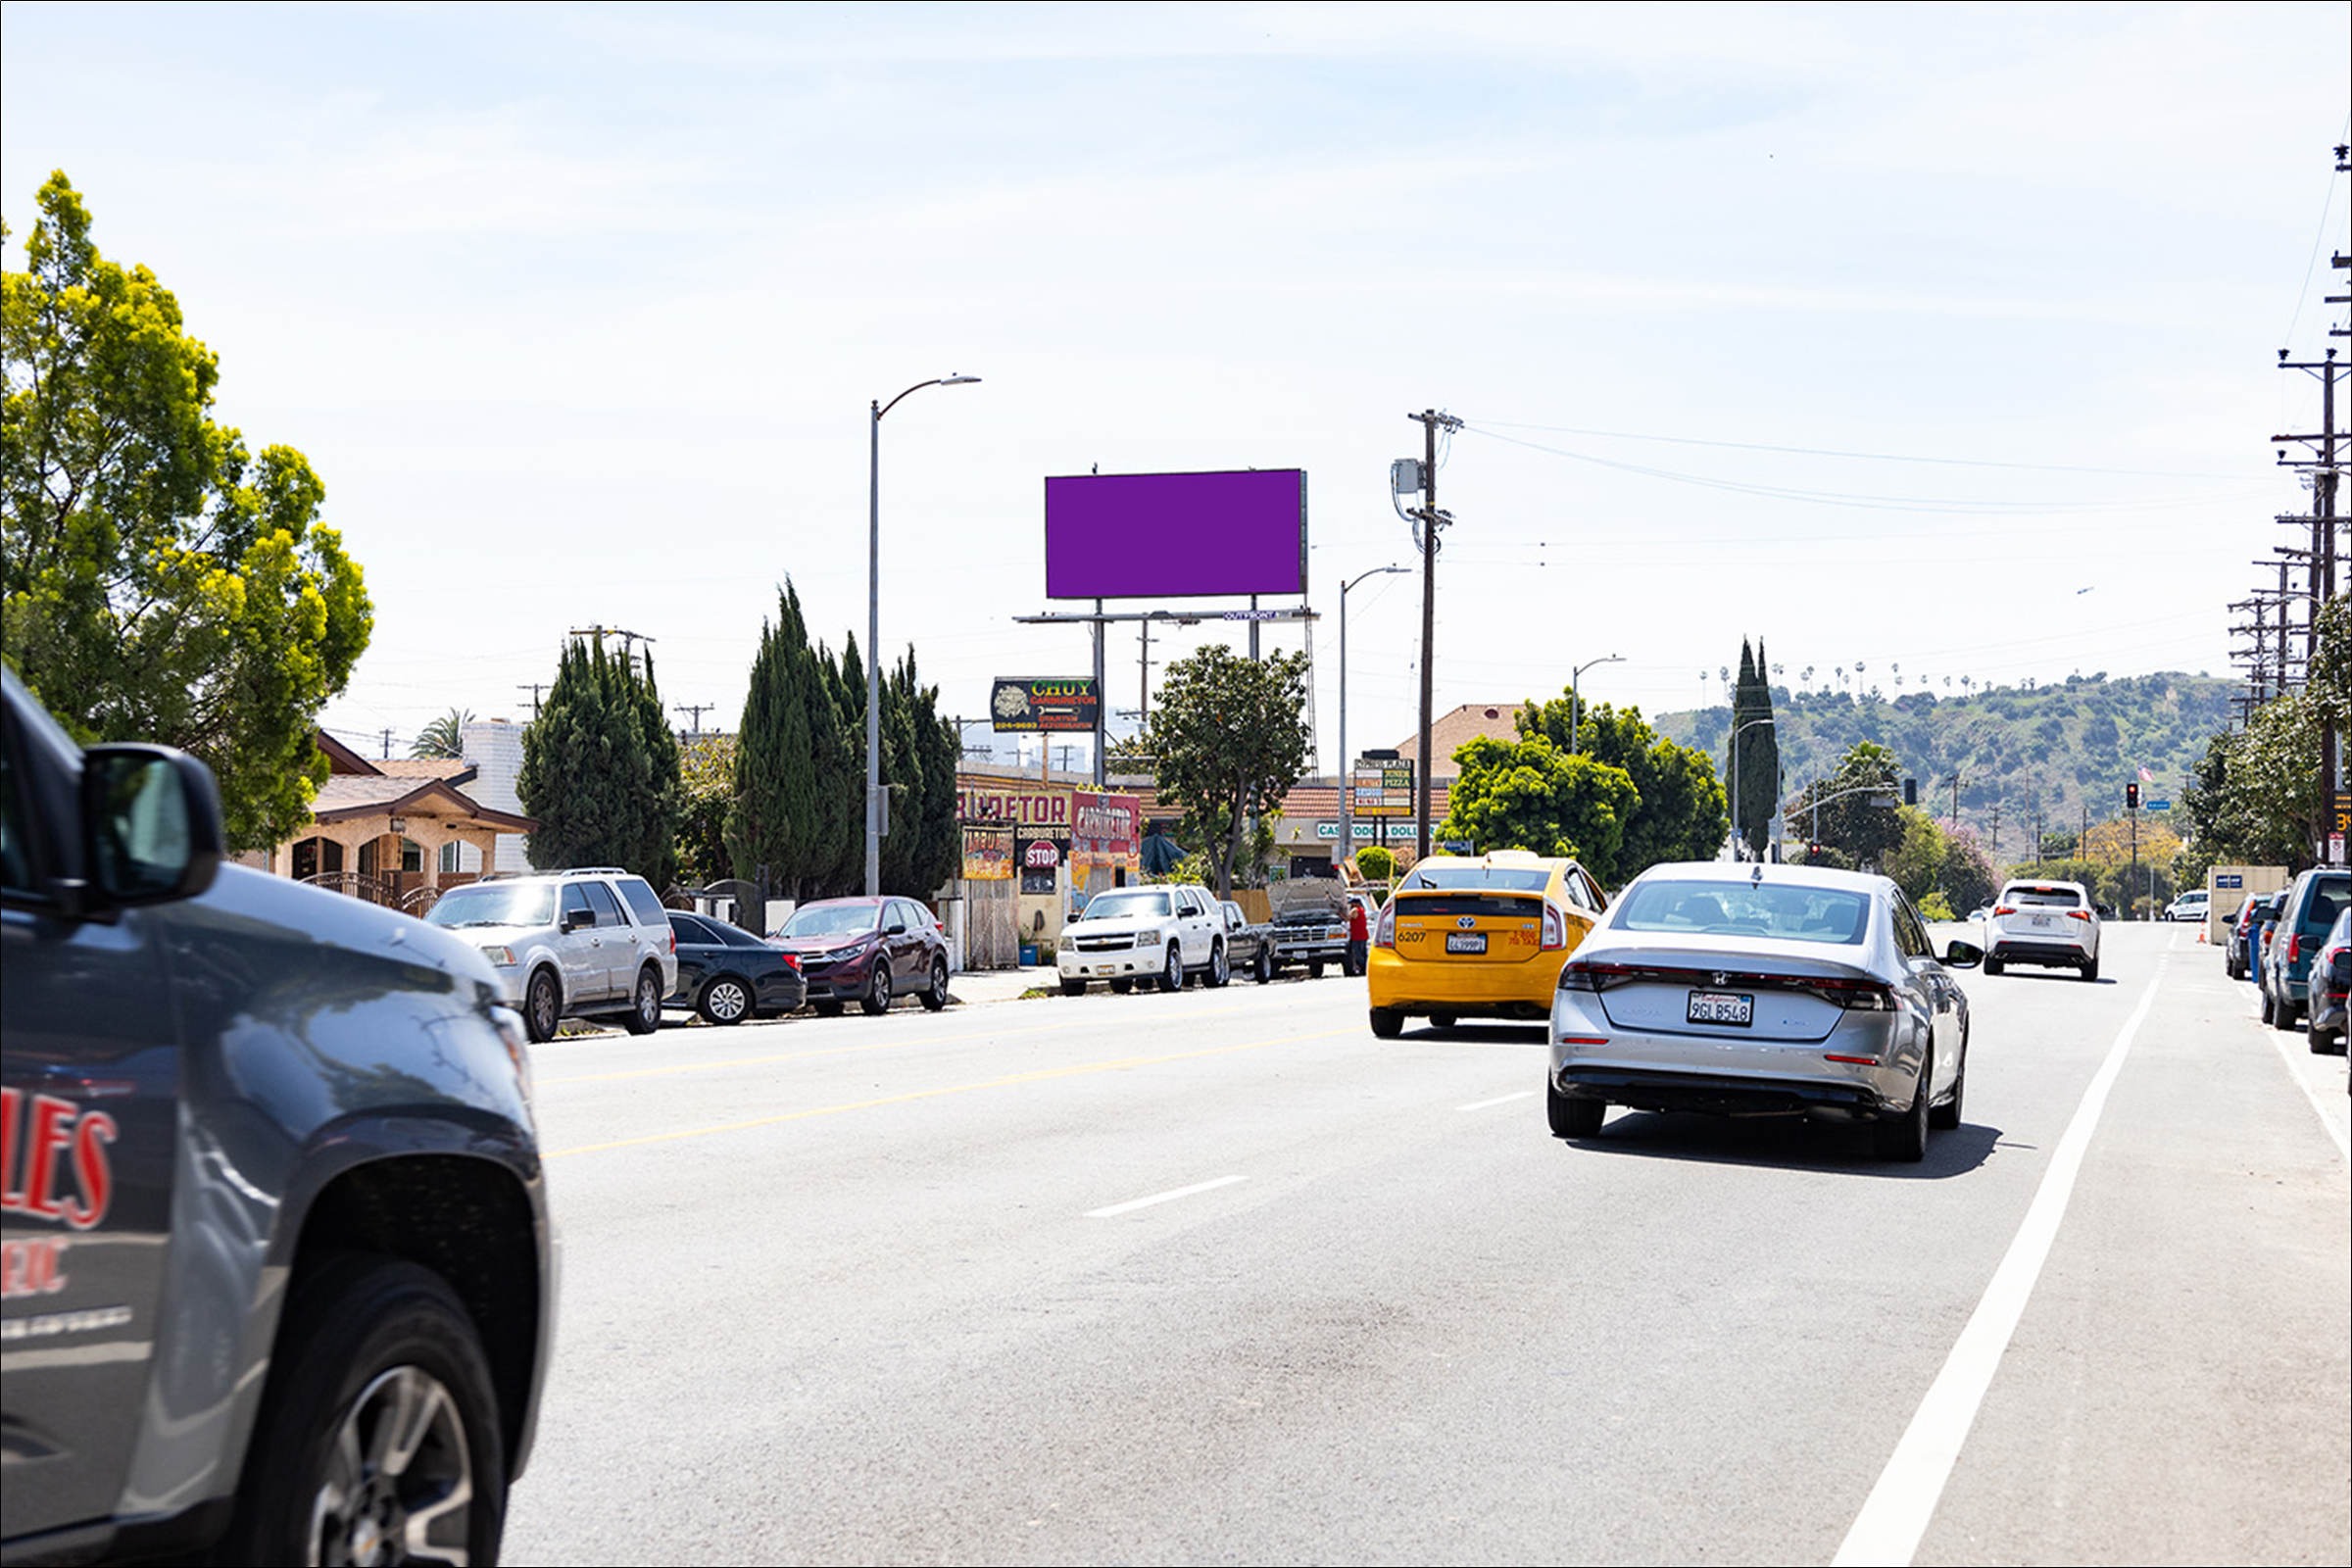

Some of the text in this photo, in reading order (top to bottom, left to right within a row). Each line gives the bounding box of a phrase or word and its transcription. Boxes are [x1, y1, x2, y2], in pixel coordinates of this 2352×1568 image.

[1032, 680, 1092, 696] CHUY
[1030, 696, 1097, 705] CARBURETOR
[1384, 778, 1410, 787] PIZZA
[1017, 827, 1070, 839] CARBURETOR
[1027, 849, 1057, 865] STOP
[1397, 931, 1426, 943] 6207
[1692, 1003, 1747, 1021] 9GLB548
